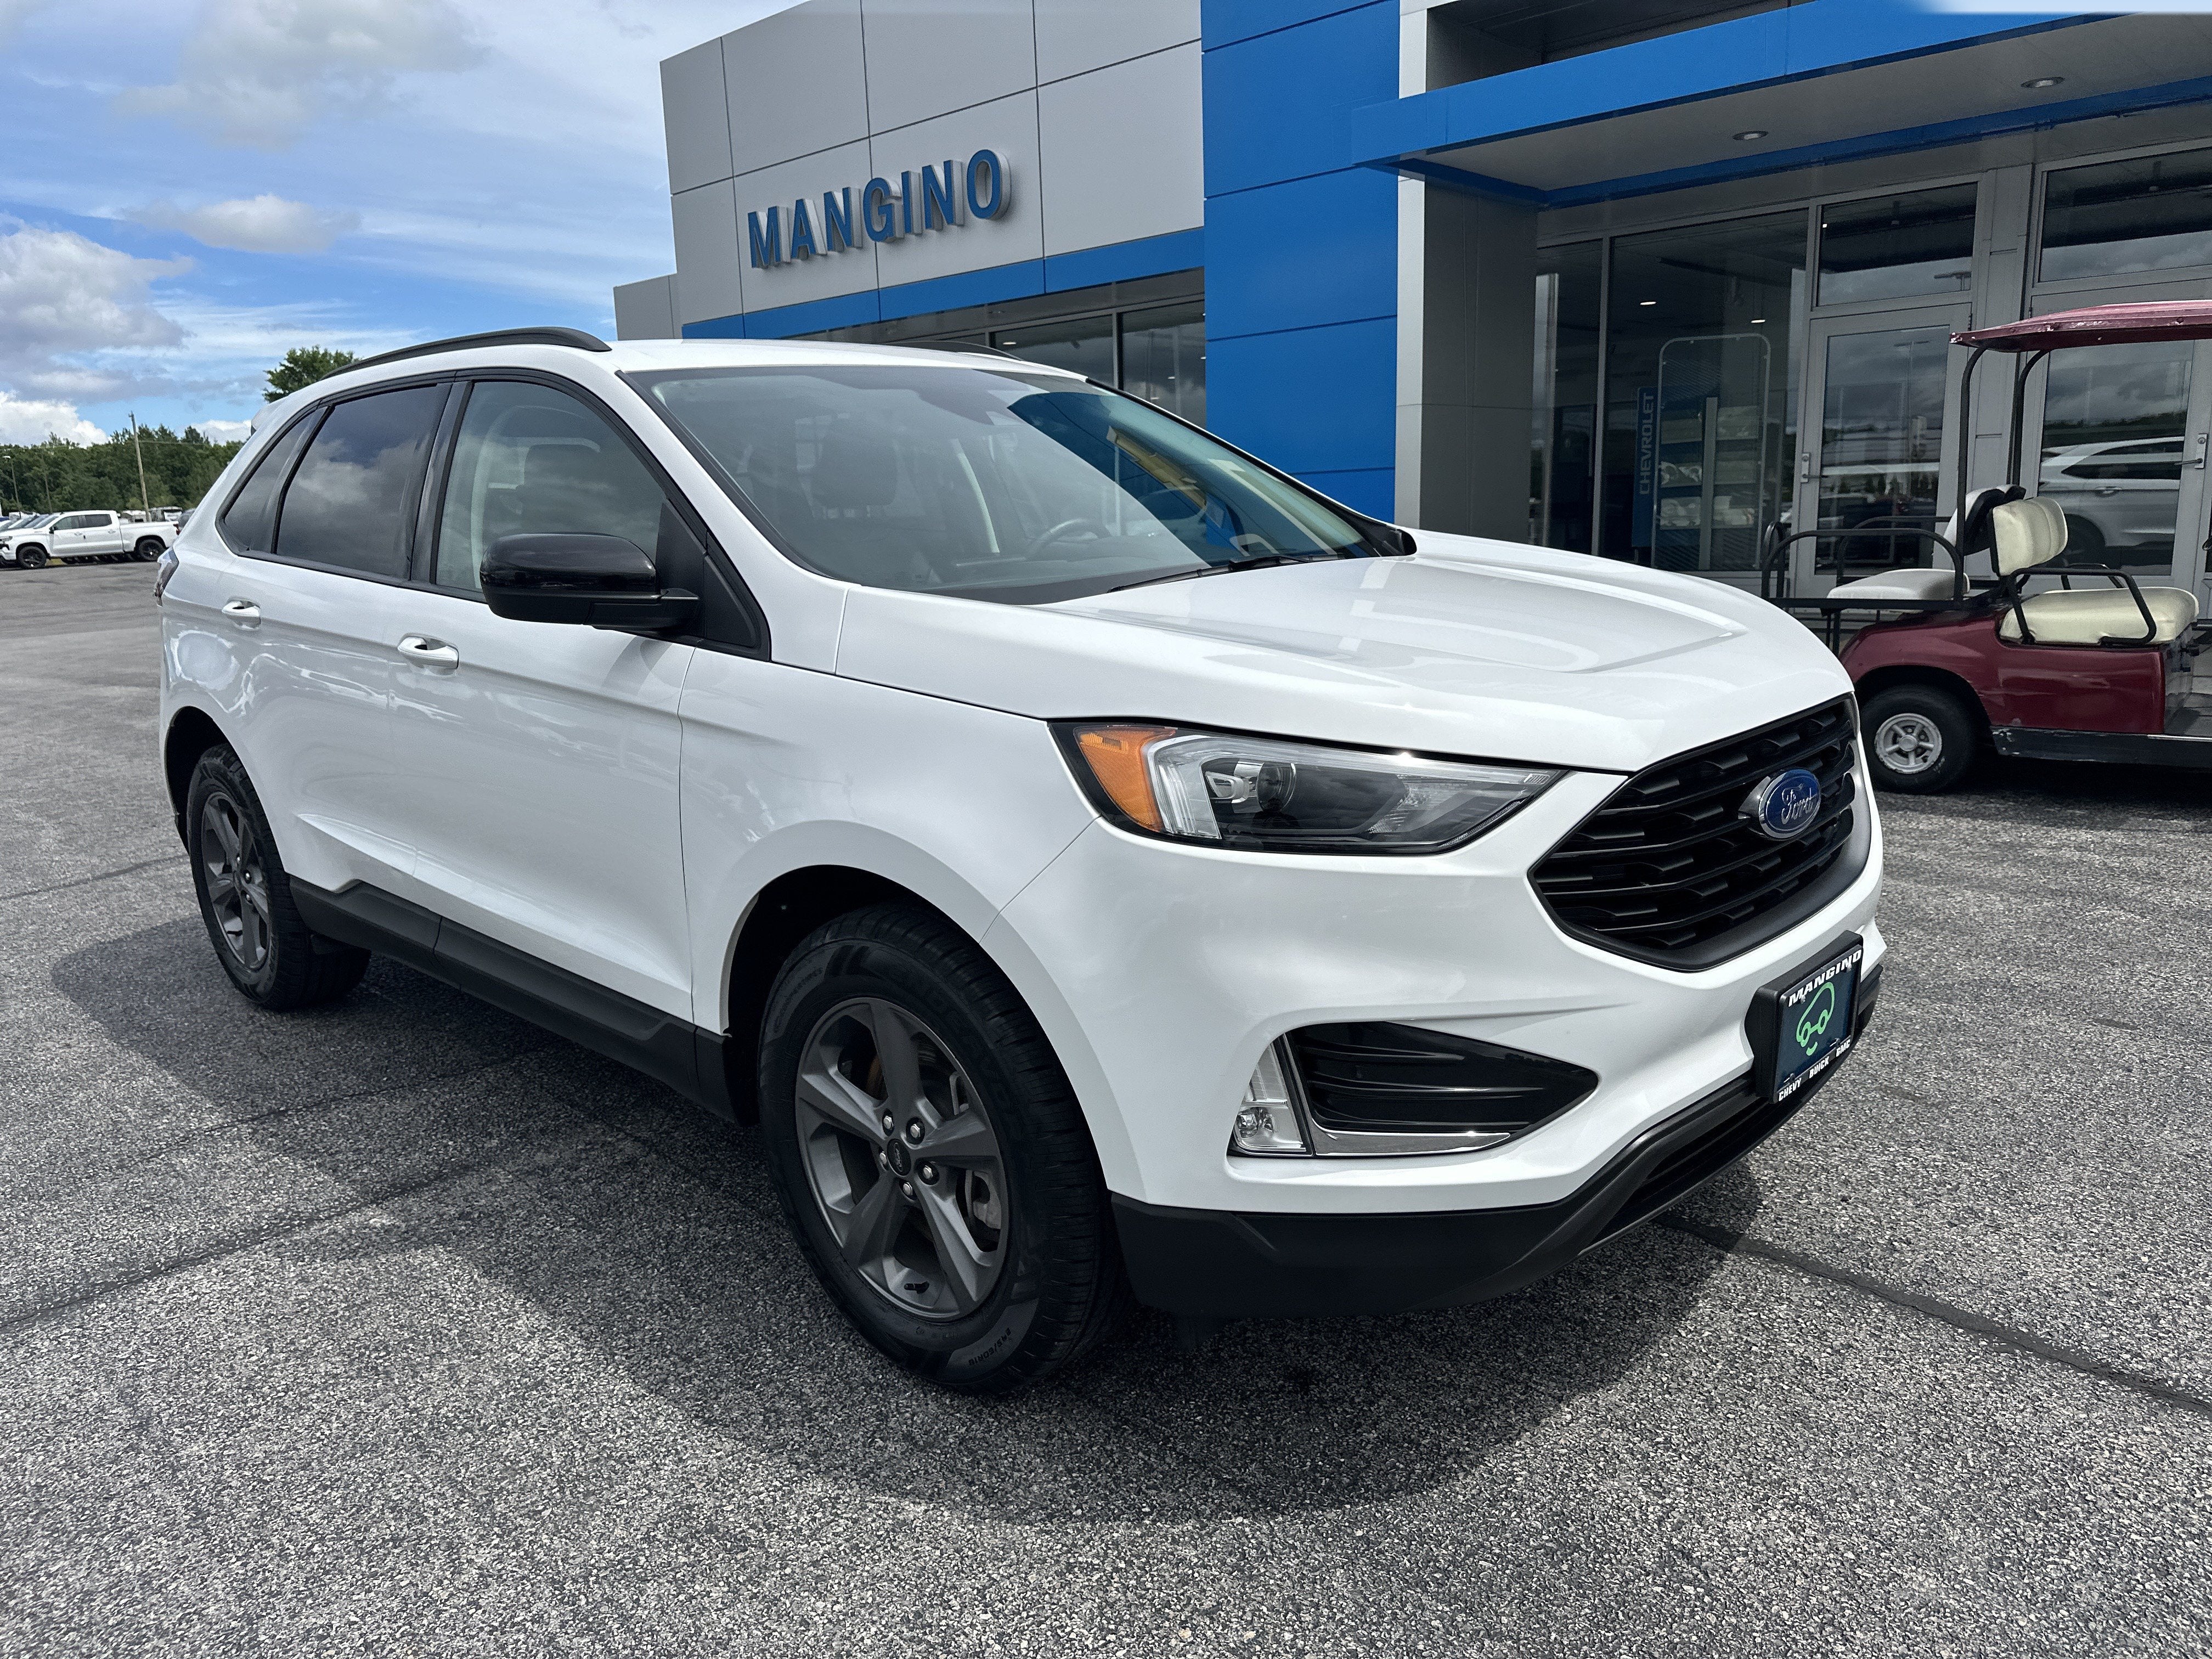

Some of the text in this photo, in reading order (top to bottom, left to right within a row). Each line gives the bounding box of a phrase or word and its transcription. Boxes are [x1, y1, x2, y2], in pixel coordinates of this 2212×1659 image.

[748, 149, 1008, 268] MANGINO
[1640, 392, 1654, 495] CHEVROLET
[1781, 783, 1817, 825] Ford
[1788, 949, 1862, 1007] MANGINO
[1779, 1039, 1850, 1102] CHEVY BUICK GMC
